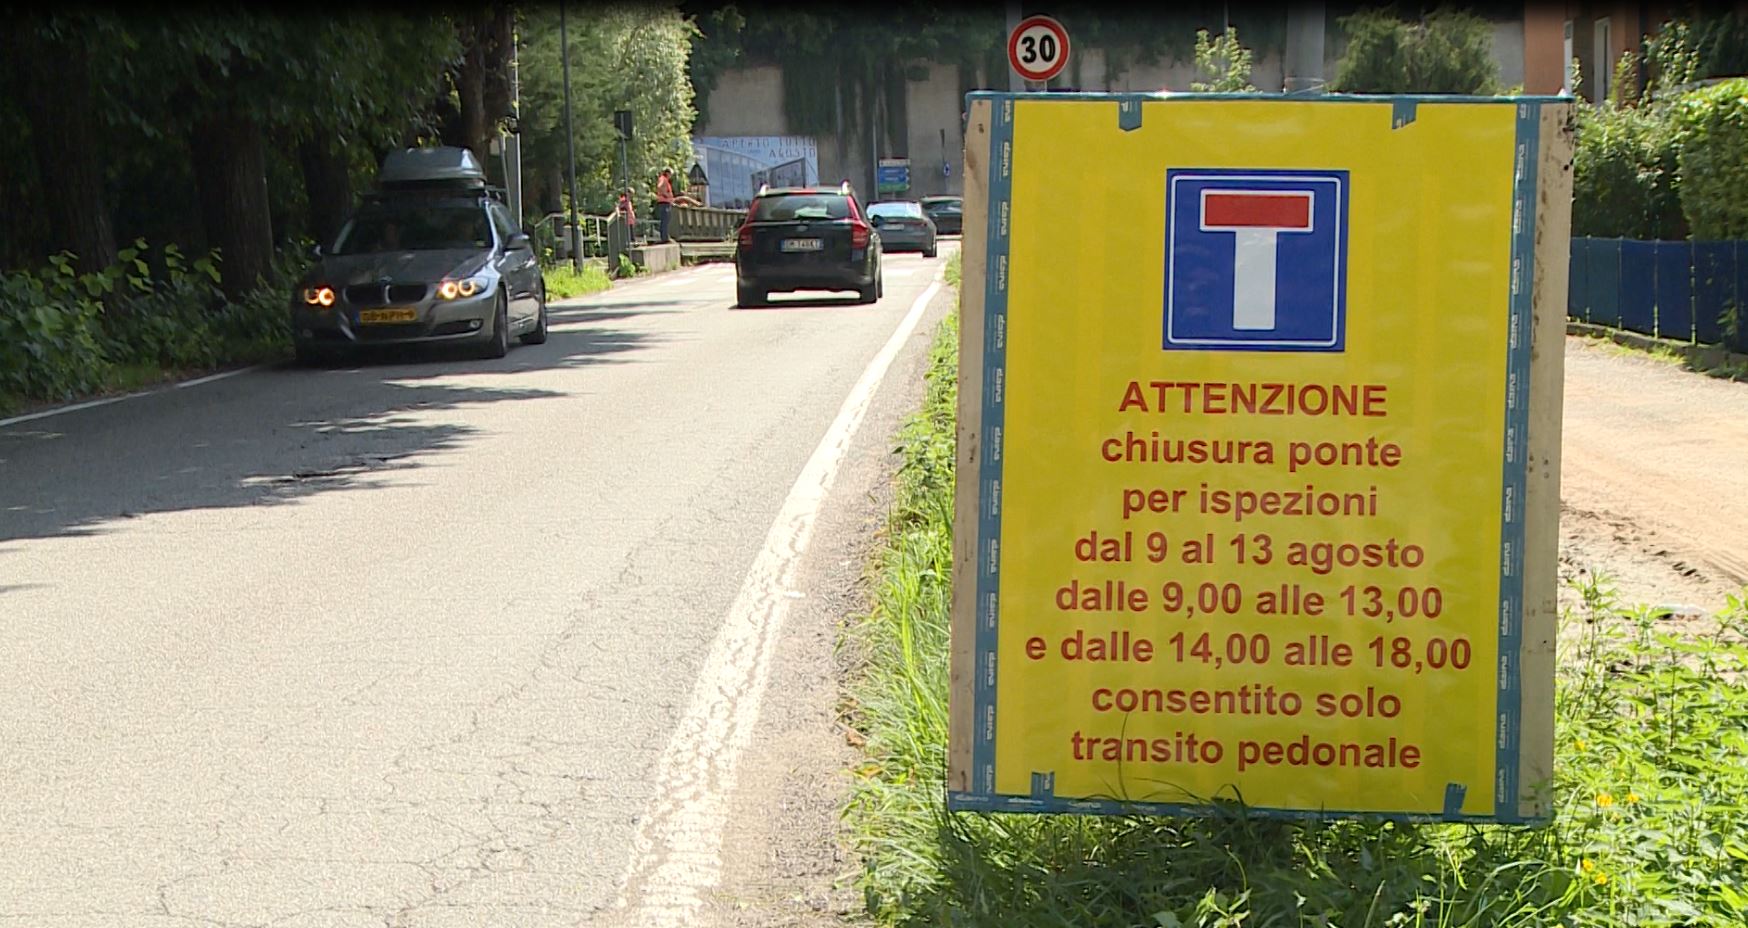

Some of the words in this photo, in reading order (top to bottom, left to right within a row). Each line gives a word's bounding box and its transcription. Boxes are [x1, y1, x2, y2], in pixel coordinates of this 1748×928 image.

[1022, 34, 1056, 63] 30
[1118, 380, 1388, 418] ATTENZIONE
[1101, 431, 1275, 465] chiusura
[1288, 436, 1402, 473] ponte
[1122, 488, 1188, 521] per
[1200, 482, 1377, 523] ispezioni
[1074, 530, 1133, 563] dal
[1146, 531, 1168, 564] 9
[1181, 532, 1214, 564] al
[1229, 533, 1273, 566] 13
[1286, 537, 1425, 576] agosto
[1055, 579, 1149, 613] dalle
[1162, 581, 1243, 620] 9,00
[1255, 583, 1325, 617] alle
[1339, 584, 1443, 624] 13,00
[1024, 636, 1048, 661] e
[1060, 629, 1154, 663] dalle
[1168, 631, 1271, 671] 14,00
[1283, 634, 1354, 668] alle
[1368, 635, 1472, 675] 18,00
[1091, 682, 1303, 720] consentito
[1314, 685, 1403, 719] solo
[1071, 730, 1224, 764] transito
[1236, 733, 1422, 773] pedonale
